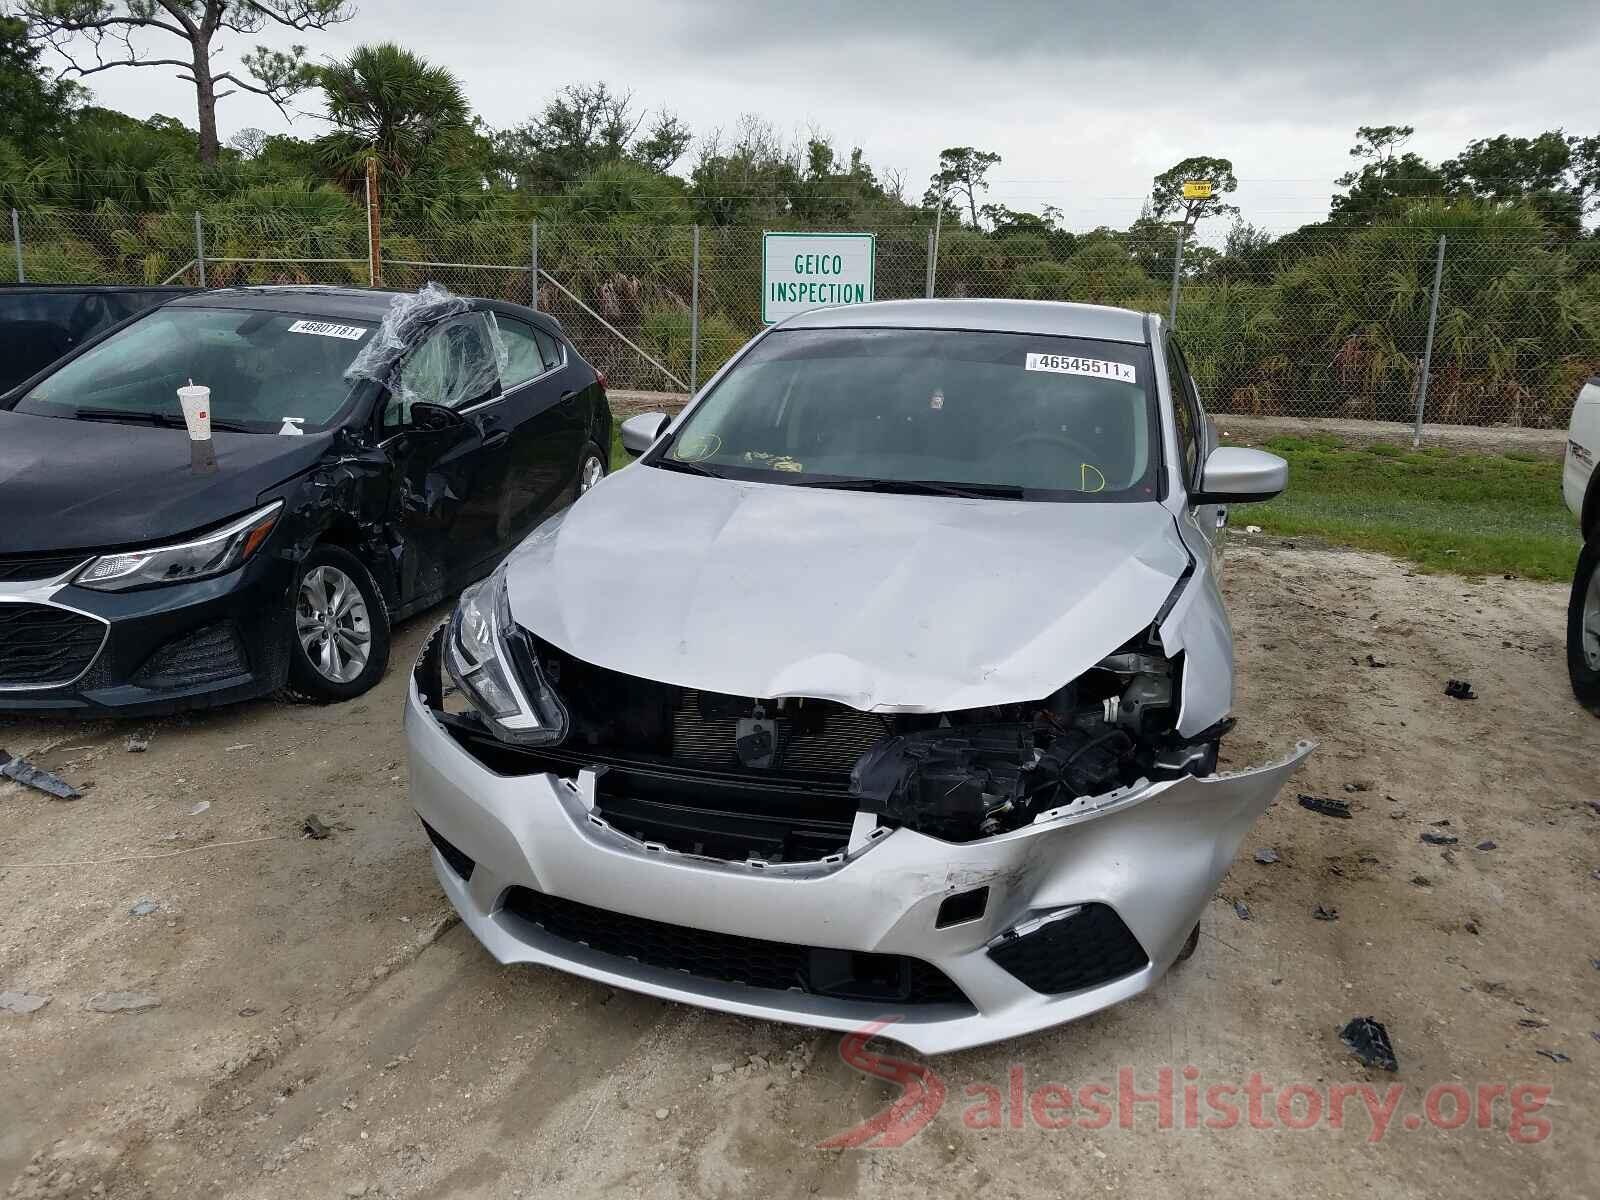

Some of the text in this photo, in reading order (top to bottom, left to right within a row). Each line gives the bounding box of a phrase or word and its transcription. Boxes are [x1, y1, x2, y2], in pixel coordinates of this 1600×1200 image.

[795, 254, 842, 275] GEICO
[771, 282, 865, 304] INSPECTION
[1080, 463, 1105, 493] D
